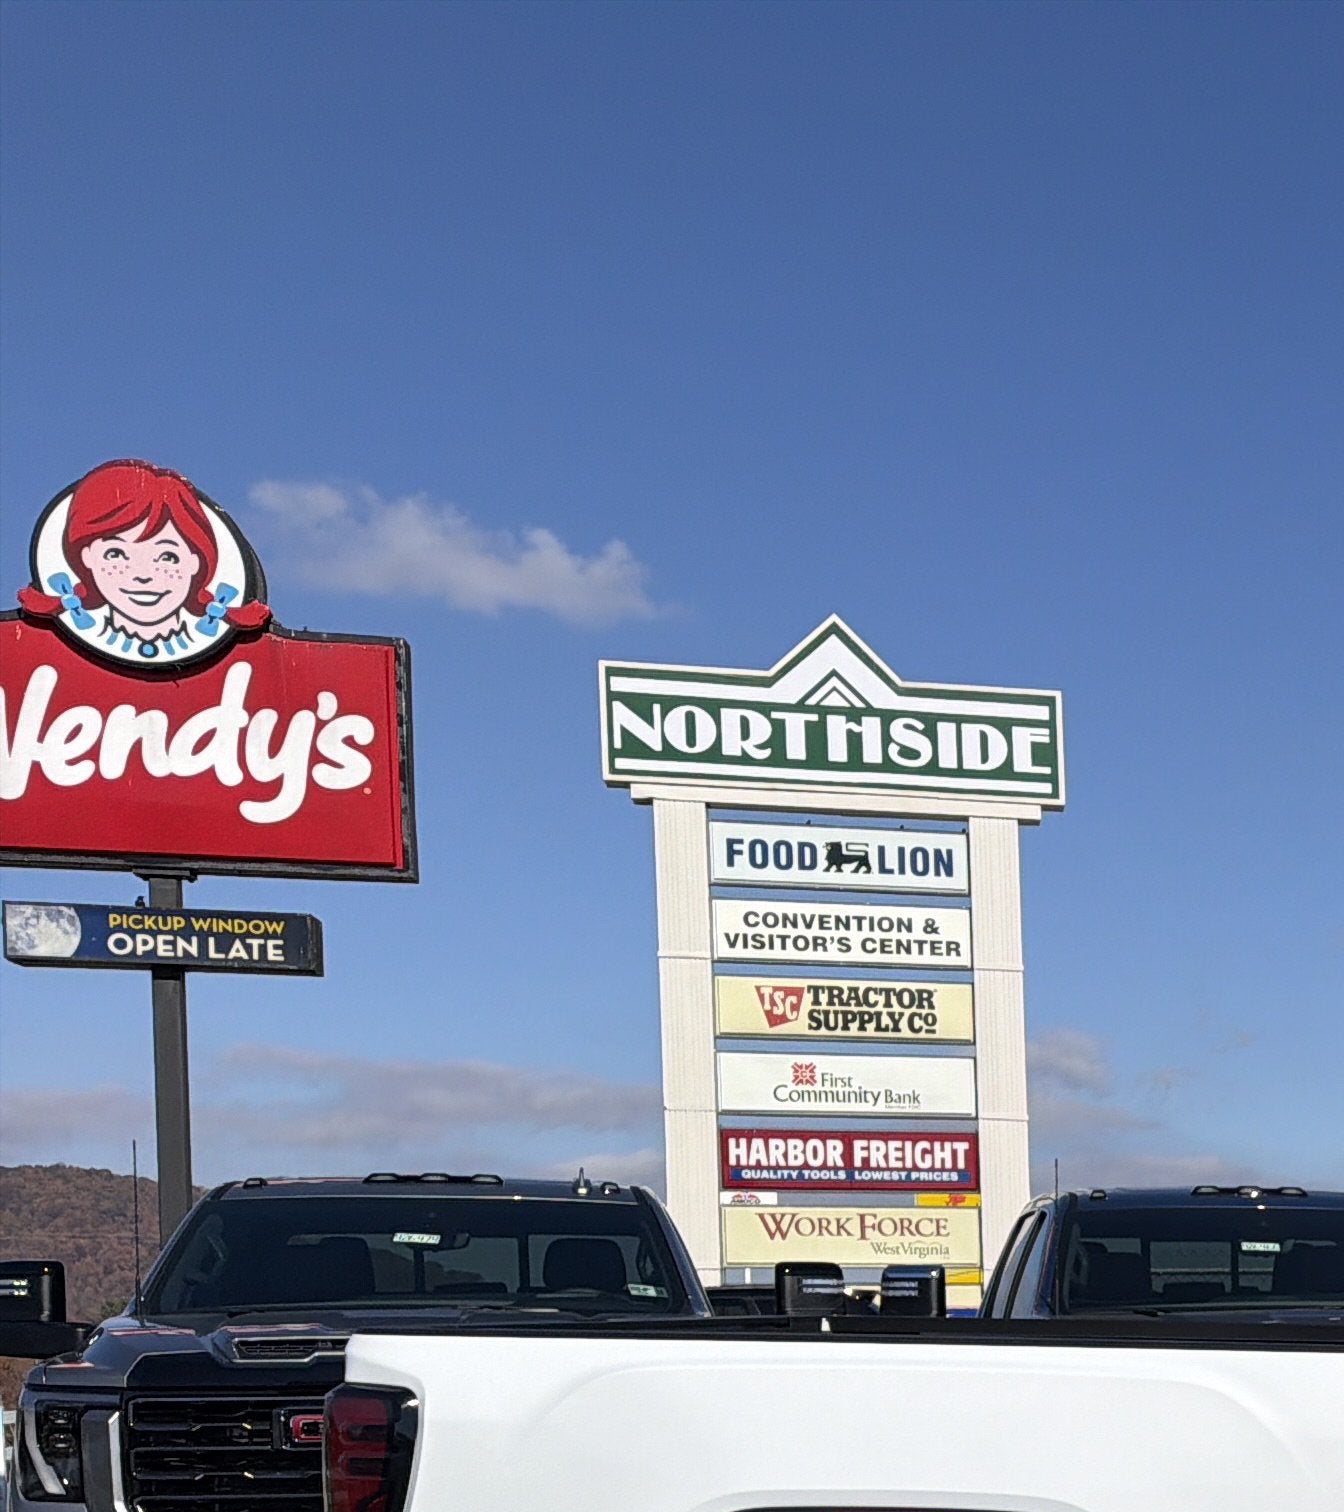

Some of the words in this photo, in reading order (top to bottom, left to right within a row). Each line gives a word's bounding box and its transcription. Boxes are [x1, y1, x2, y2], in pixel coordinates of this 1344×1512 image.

[612, 701, 1052, 775] NORTHSIDE
[726, 838, 818, 872] FOOD
[878, 846, 954, 878] LION
[108, 913, 186, 931] PICKUP
[191, 916, 285, 935] WINDOW
[742, 911, 913, 934] CONVENTION
[922, 917, 941, 935] &
[106, 932, 198, 959] OPEN
[207, 936, 285, 961] LATE
[724, 931, 851, 953] VISITOR'S
[861, 937, 962, 958] CENTER
[760, 986, 799, 1022] TSC
[807, 985, 936, 1010] TRACTOR
[808, 1009, 907, 1033] SUPPLY
[821, 1072, 853, 1088] First
[773, 1084, 881, 1107] Community
[884, 1089, 921, 1105] Bank
[728, 1137, 845, 1167] HARBOR
[853, 1139, 970, 1170] FREIGHT
[741, 1169, 799, 1180] QUALITY
[802, 1170, 846, 1180] TOOLS
[854, 1170, 908, 1181] LOWEST
[911, 1171, 959, 1182] PRICES
[755, 1212, 855, 1241] WORK
[856, 1212, 950, 1241] FORCE
[870, 1241, 901, 1256] West
[899, 1240, 950, 1259] Virginia
